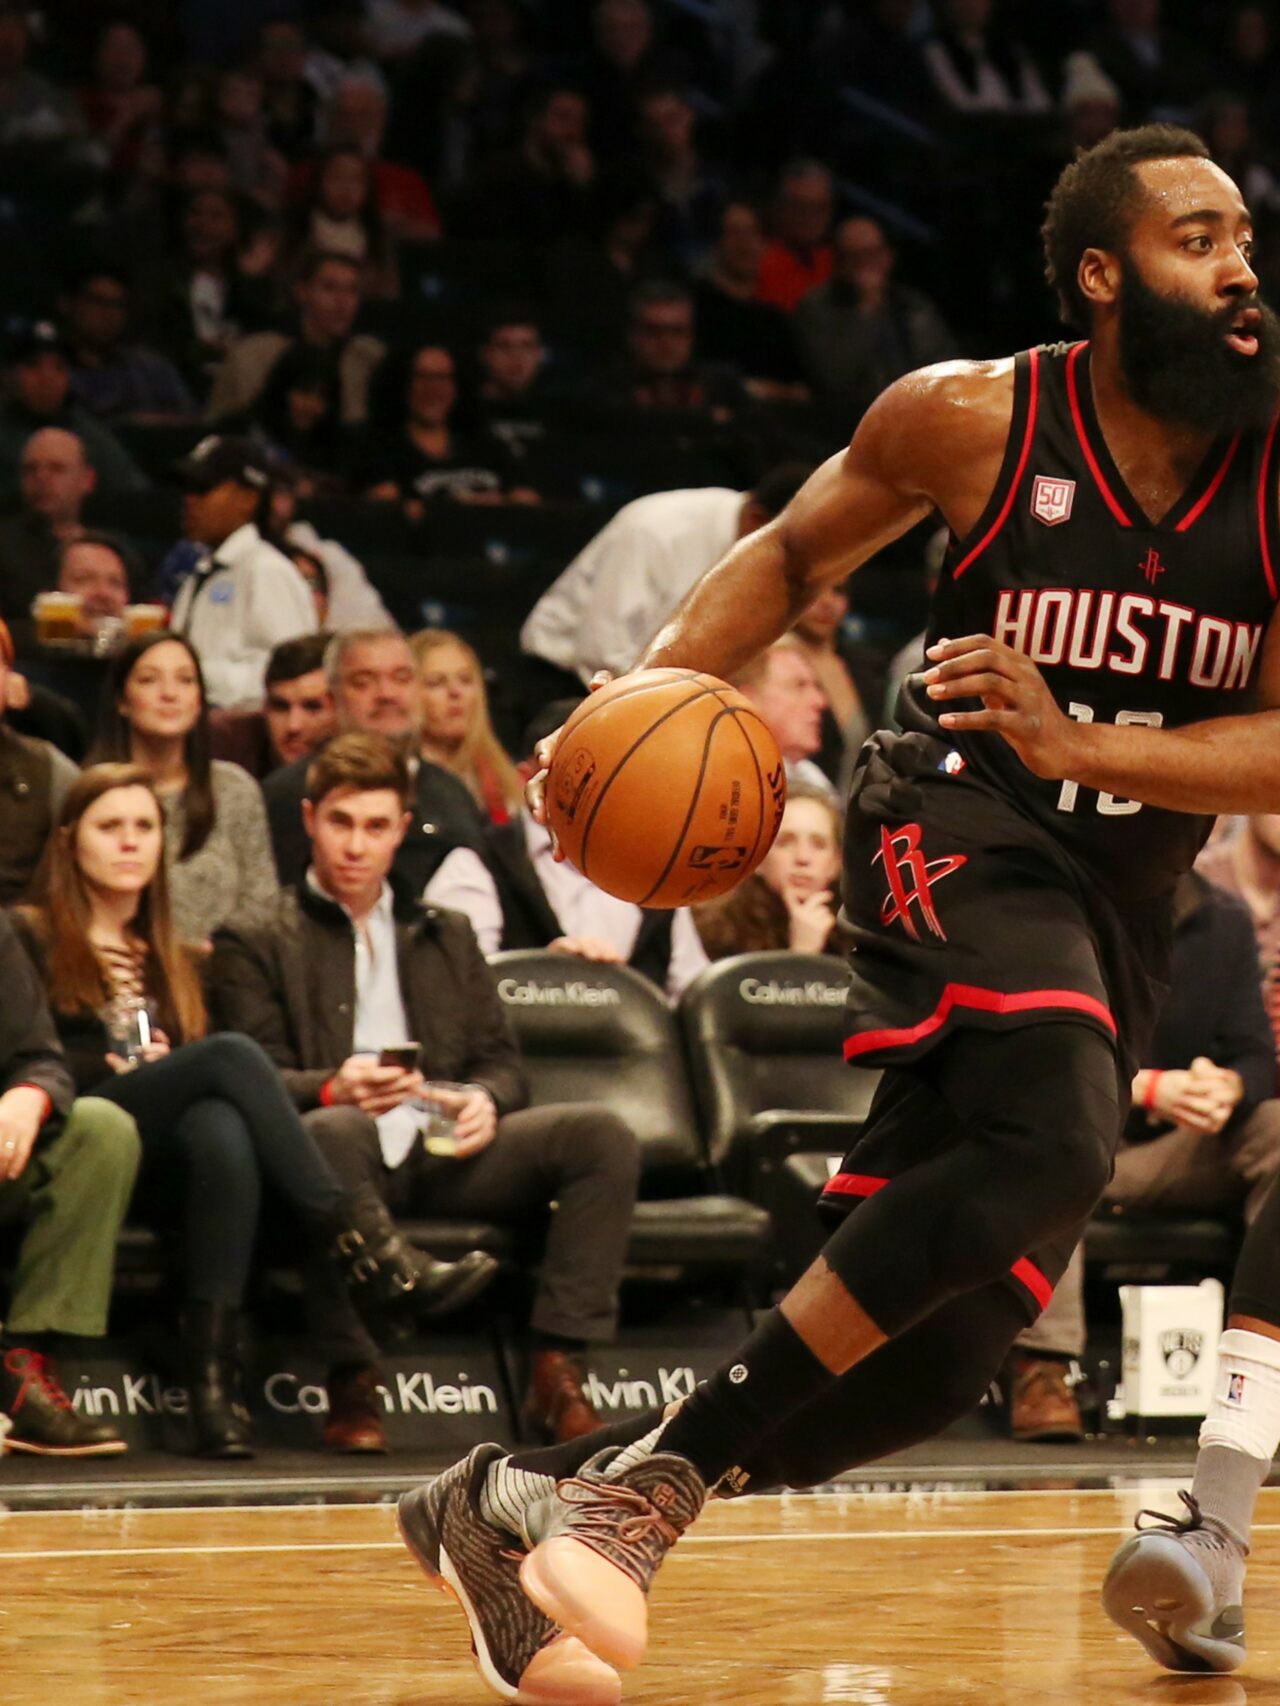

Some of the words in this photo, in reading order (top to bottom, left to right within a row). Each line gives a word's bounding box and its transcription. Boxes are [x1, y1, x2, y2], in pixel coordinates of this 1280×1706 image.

[1039, 485, 1064, 507] 50
[993, 588, 1263, 690] HOUSTON
[497, 978, 566, 1006] Calvin
[739, 977, 806, 1006] Calvin
[122, 1374, 190, 1415] Kle
[264, 1373, 394, 1413] Can
[396, 1372, 498, 1413] Klein
[582, 1368, 658, 1409] lvin
